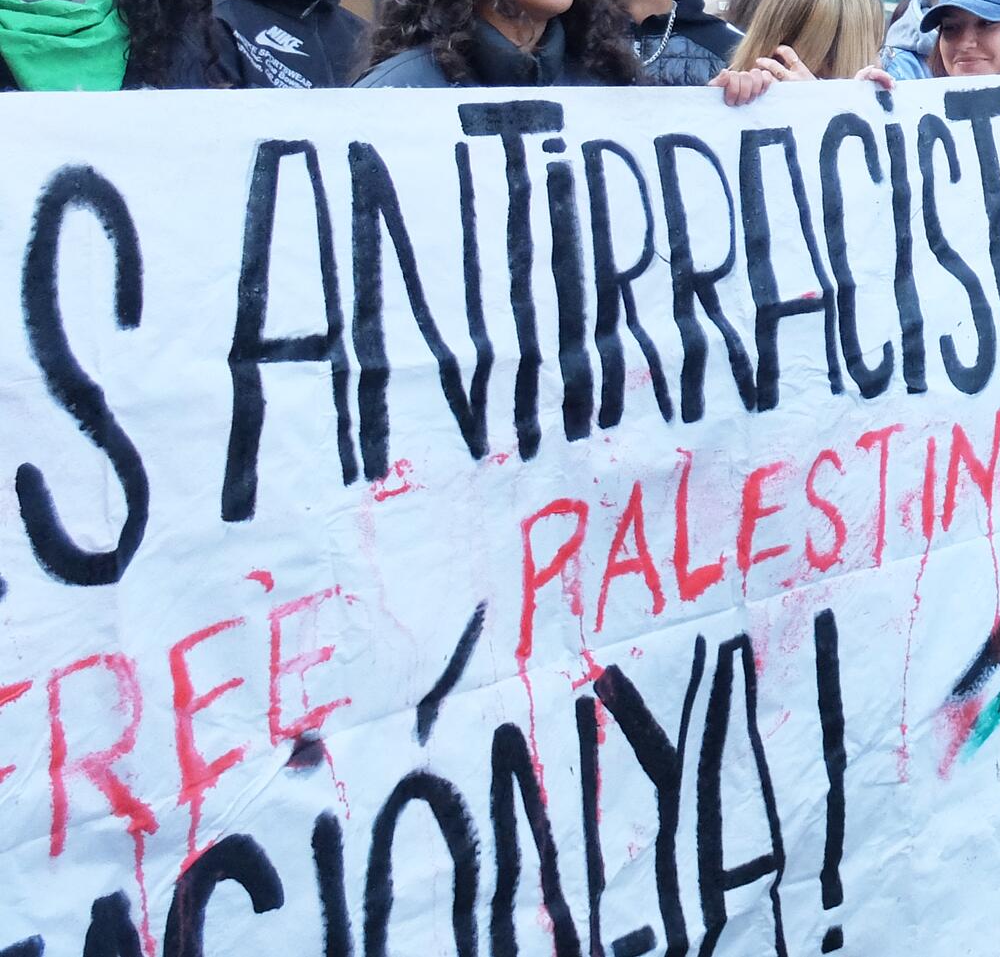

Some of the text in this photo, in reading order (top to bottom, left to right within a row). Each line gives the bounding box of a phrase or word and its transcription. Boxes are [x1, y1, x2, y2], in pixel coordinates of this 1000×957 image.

[265, 25, 304, 50] NIKE
[0, 162, 149, 586] S
[0, 584, 353, 858] REE
